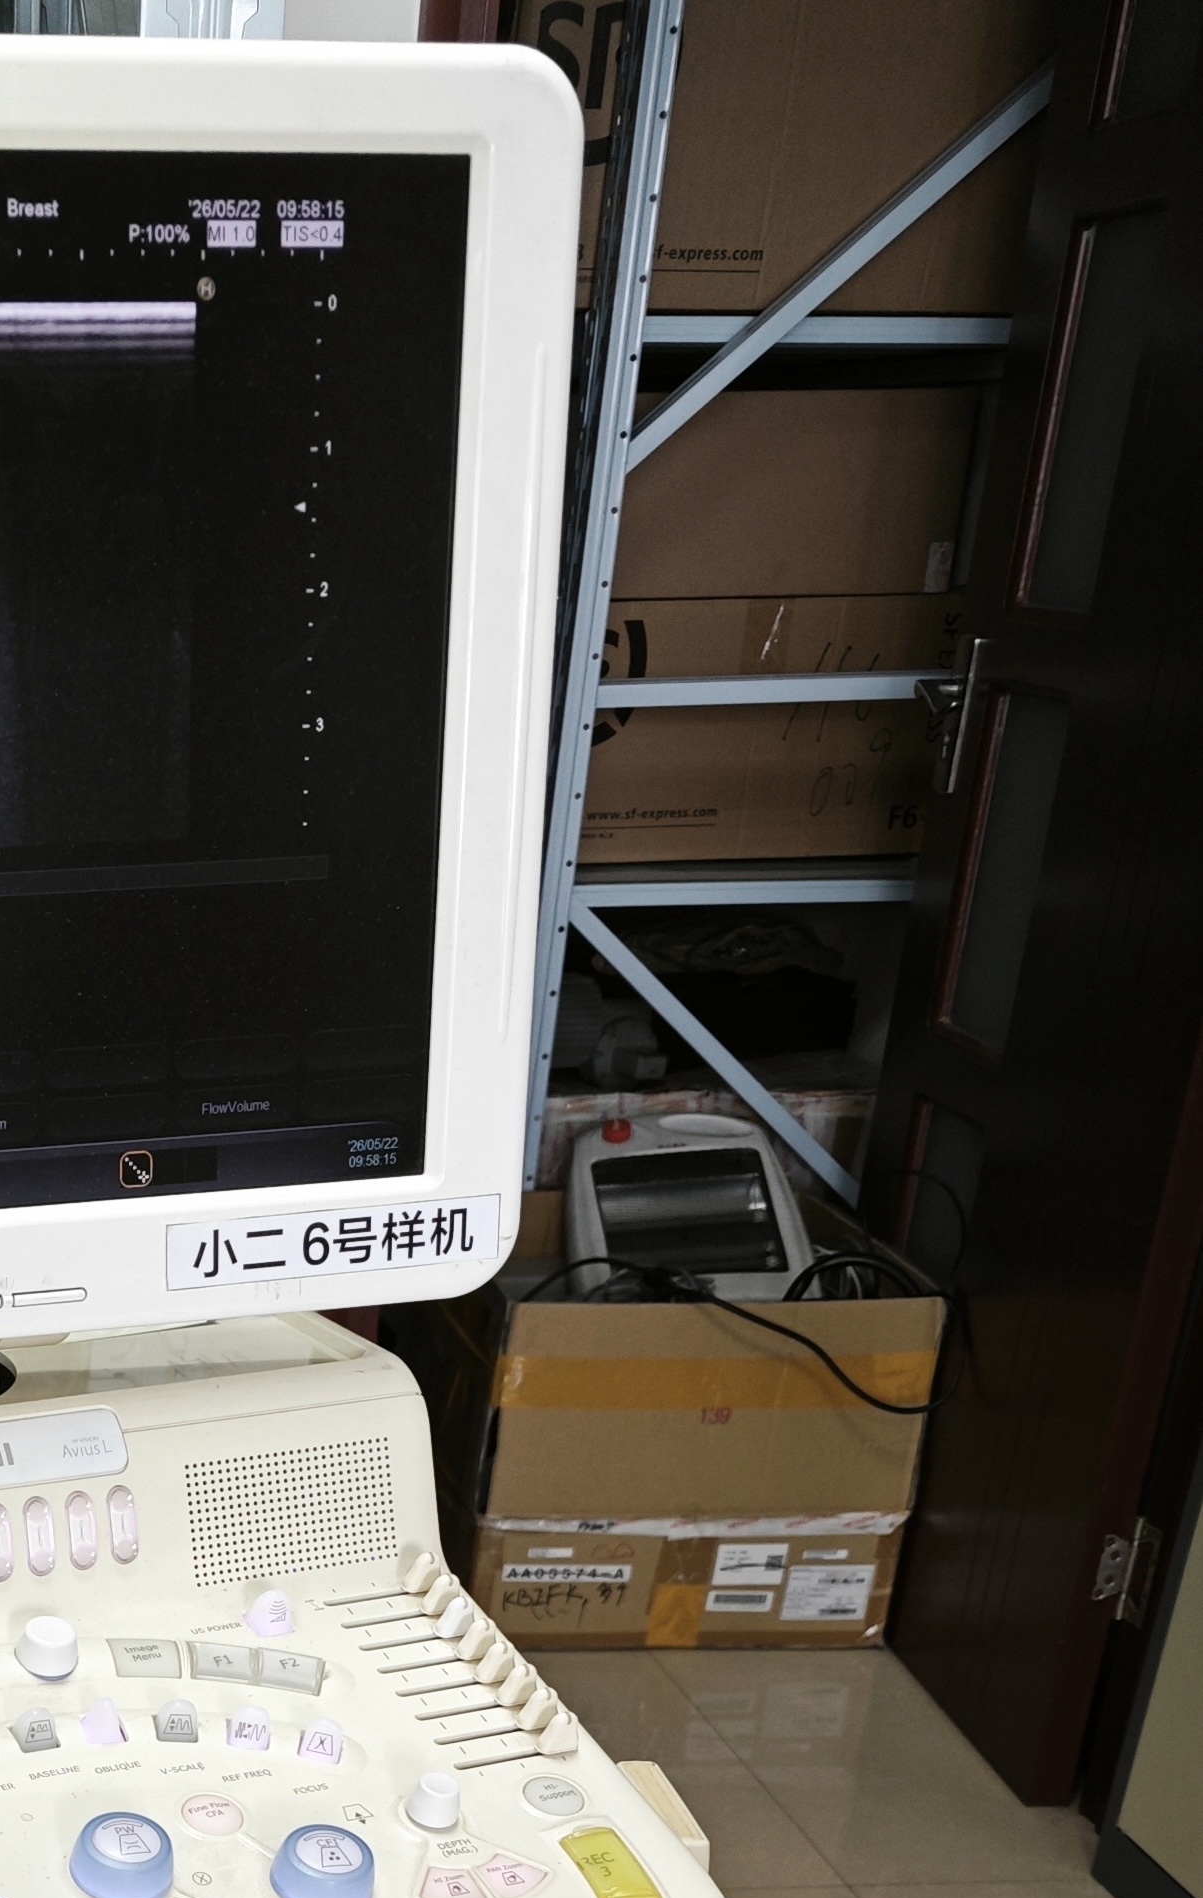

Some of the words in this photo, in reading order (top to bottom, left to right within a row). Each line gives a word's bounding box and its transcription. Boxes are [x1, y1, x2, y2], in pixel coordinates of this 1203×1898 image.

[7, 198, 59, 217] Breast
[188, 199, 261, 218] '26/05/22
[277, 199, 344, 219] 09:58:15
[128, 224, 190, 243] P:100%
[208, 225, 226, 242] MI
[231, 225, 255, 242] 1.0
[283, 225, 342, 243] TIS<0.4
[327, 296, 337, 311] 0
[319, 583, 328, 597] 2
[315, 718, 324, 730] 3
[201, 1098, 270, 1115] FlowVolume
[348, 1153, 396, 1168] 09:58:15
[192, 1228, 286, 1279] 小二
[302, 1207, 475, 1267] 6号样机
[190, 1627, 206, 1635] US
[207, 1622, 243, 1632] POWER
[123, 1641, 160, 1655] Image
[131, 1650, 162, 1663] Menu
[213, 1655, 233, 1667] F1
[279, 1658, 300, 1670] F2
[28, 1764, 82, 1781] BASELINE
[94, 1761, 143, 1774] OBLIQUE
[159, 1762, 205, 1775] V-SCALE
[221, 1771, 241, 1783] REF
[243, 1768, 273, 1781] FREQ
[293, 1783, 329, 1796] FOCUS
[539, 1789, 577, 1802] Support
[188, 1804, 207, 1815] Fine
[209, 1801, 230, 1813] Flow
[205, 1808, 225, 1818] CFA
[114, 1826, 136, 1836] PW
[437, 1839, 472, 1850] DEPTH
[442, 1845, 478, 1858] (MAG.)
[601, 1866, 611, 1878] 3
